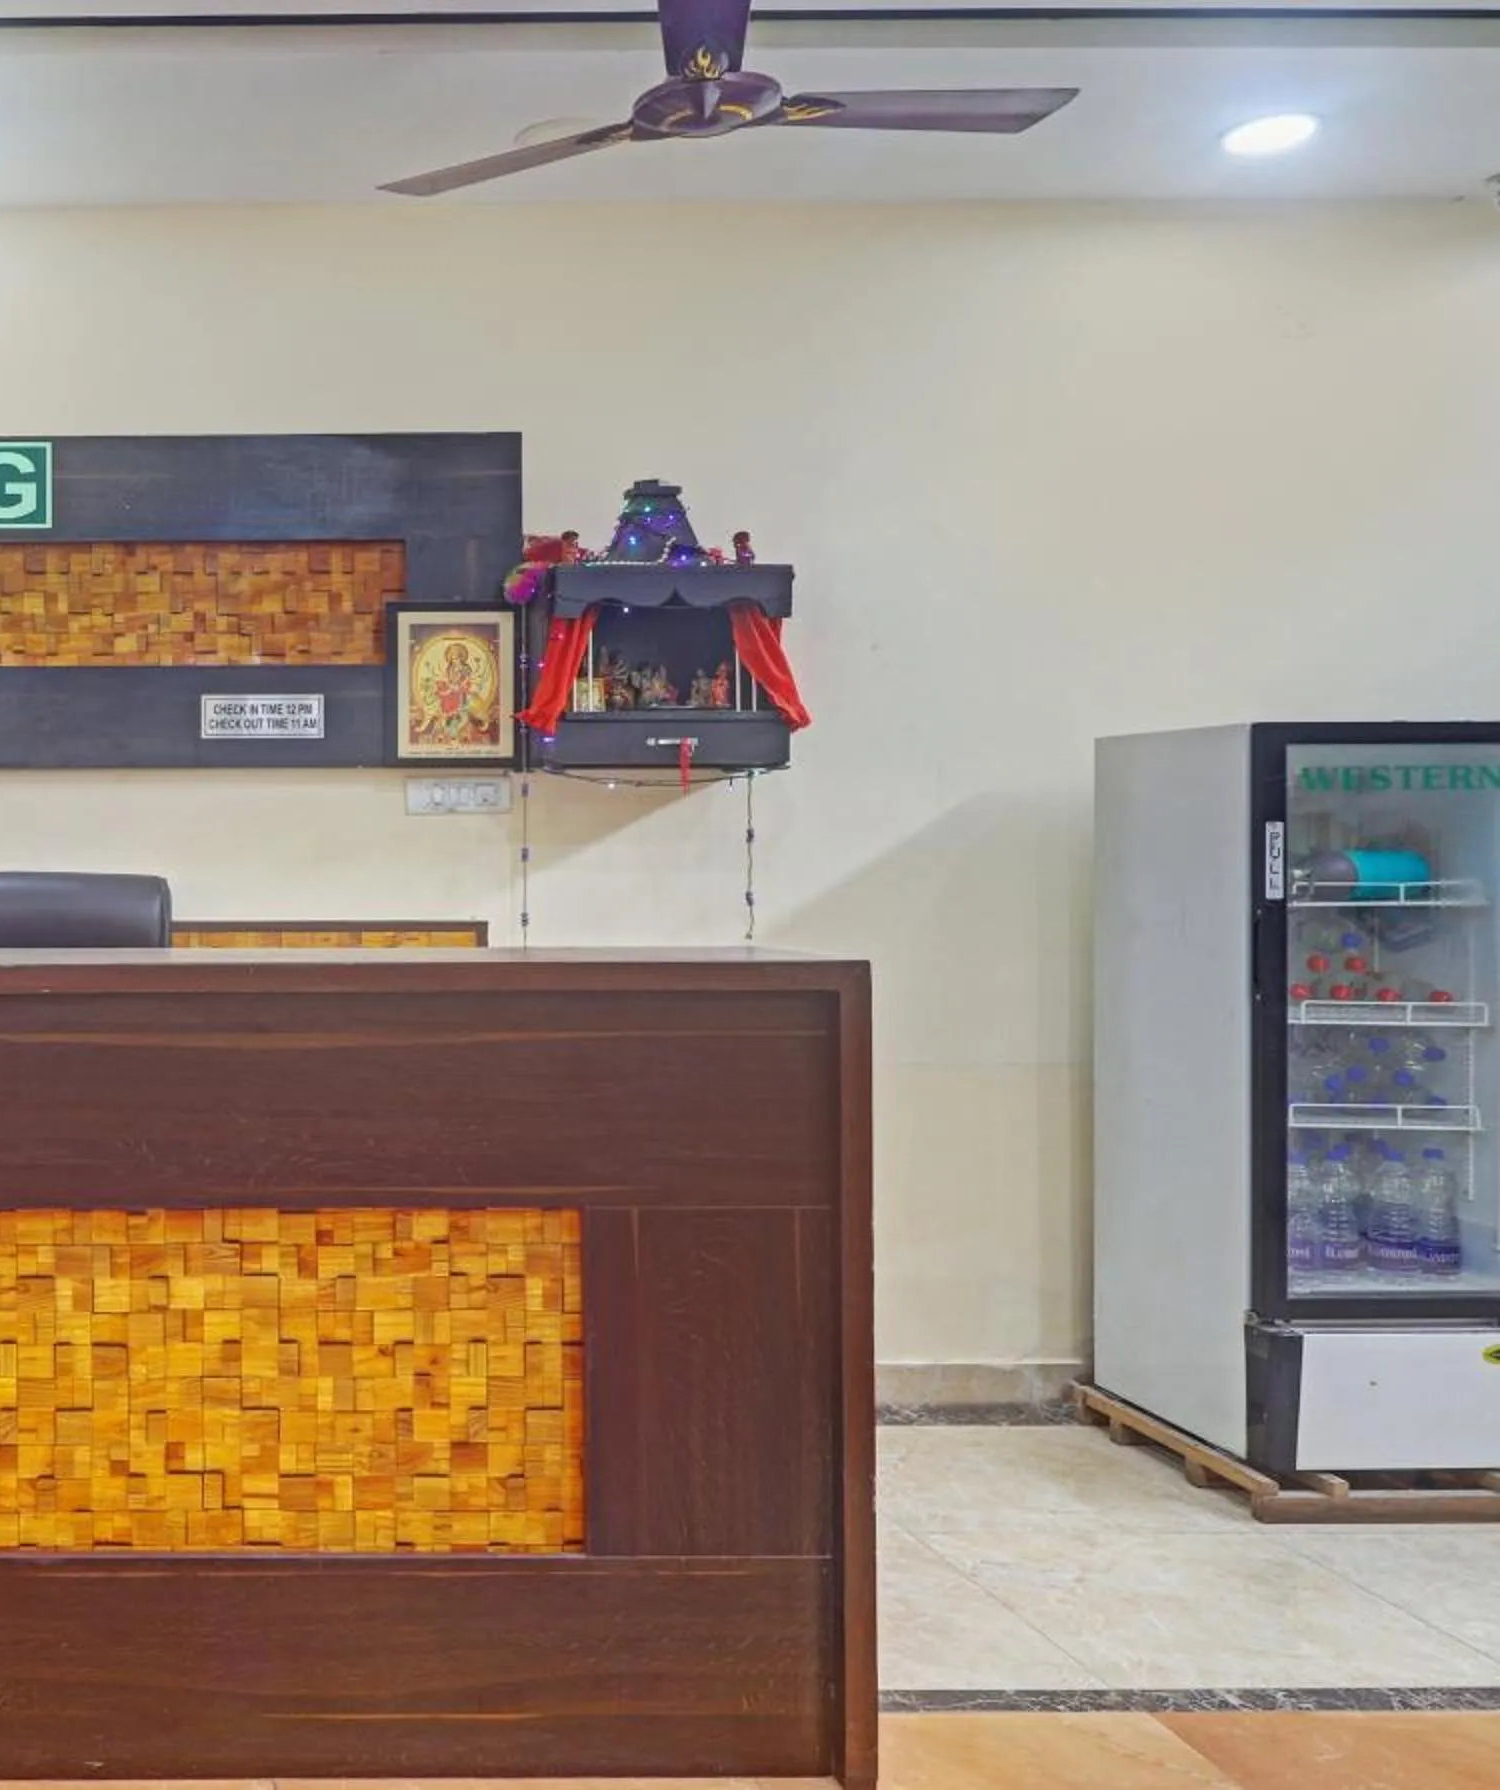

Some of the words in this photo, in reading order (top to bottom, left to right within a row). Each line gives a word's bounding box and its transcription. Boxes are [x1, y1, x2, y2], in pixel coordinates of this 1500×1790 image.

[213, 703, 246, 715] CHECK
[250, 703, 259, 715] IN
[261, 703, 283, 715] TIME
[286, 703, 297, 715] 12
[298, 703, 313, 715] PM
[209, 718, 241, 729] CHECK
[243, 718, 264, 729] OUT
[267, 718, 289, 729] TIME
[291, 718, 301, 729] 11
[303, 718, 317, 729] AM
[1300, 765, 1500, 791] WESTERN
